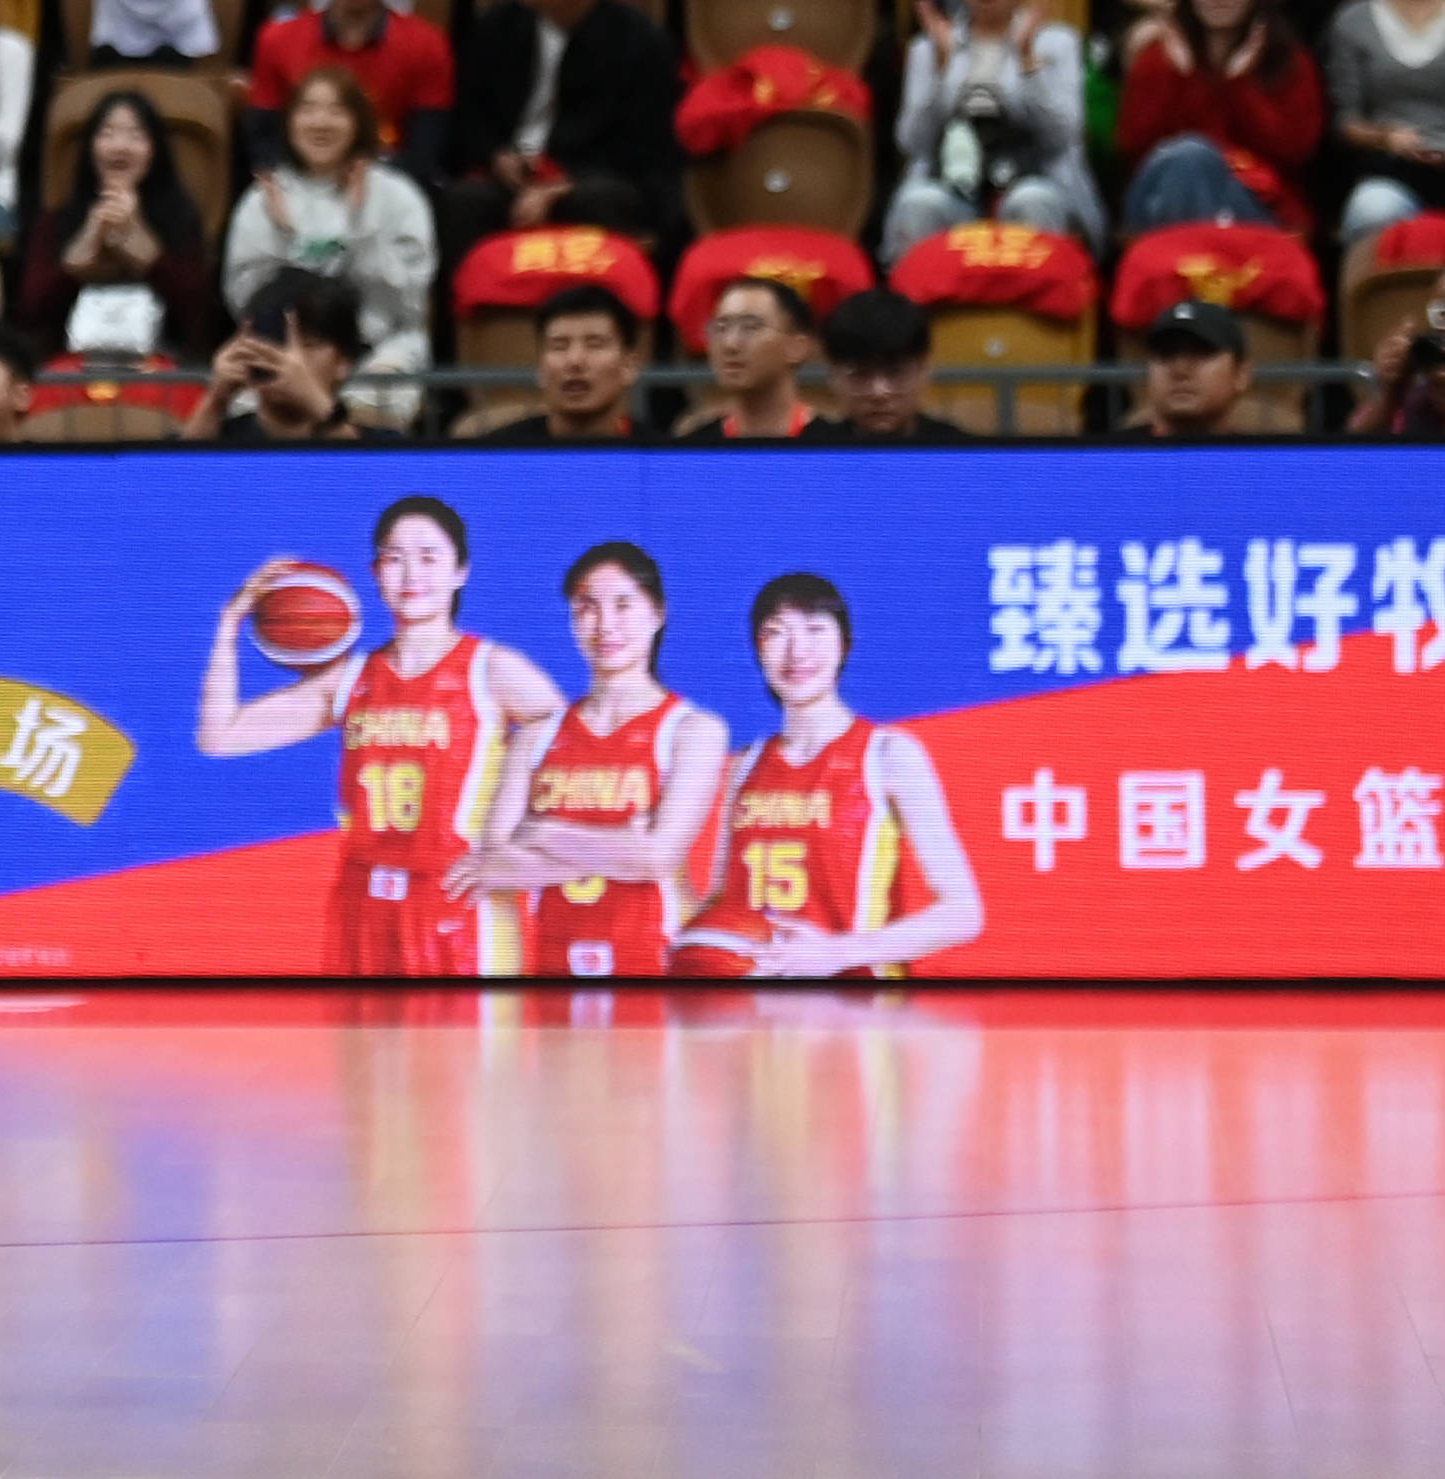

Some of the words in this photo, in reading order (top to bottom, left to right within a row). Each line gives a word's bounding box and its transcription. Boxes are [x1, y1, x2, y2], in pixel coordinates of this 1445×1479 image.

[1001, 765, 1445, 872] 中国女篮
[743, 840, 809, 911] 15
